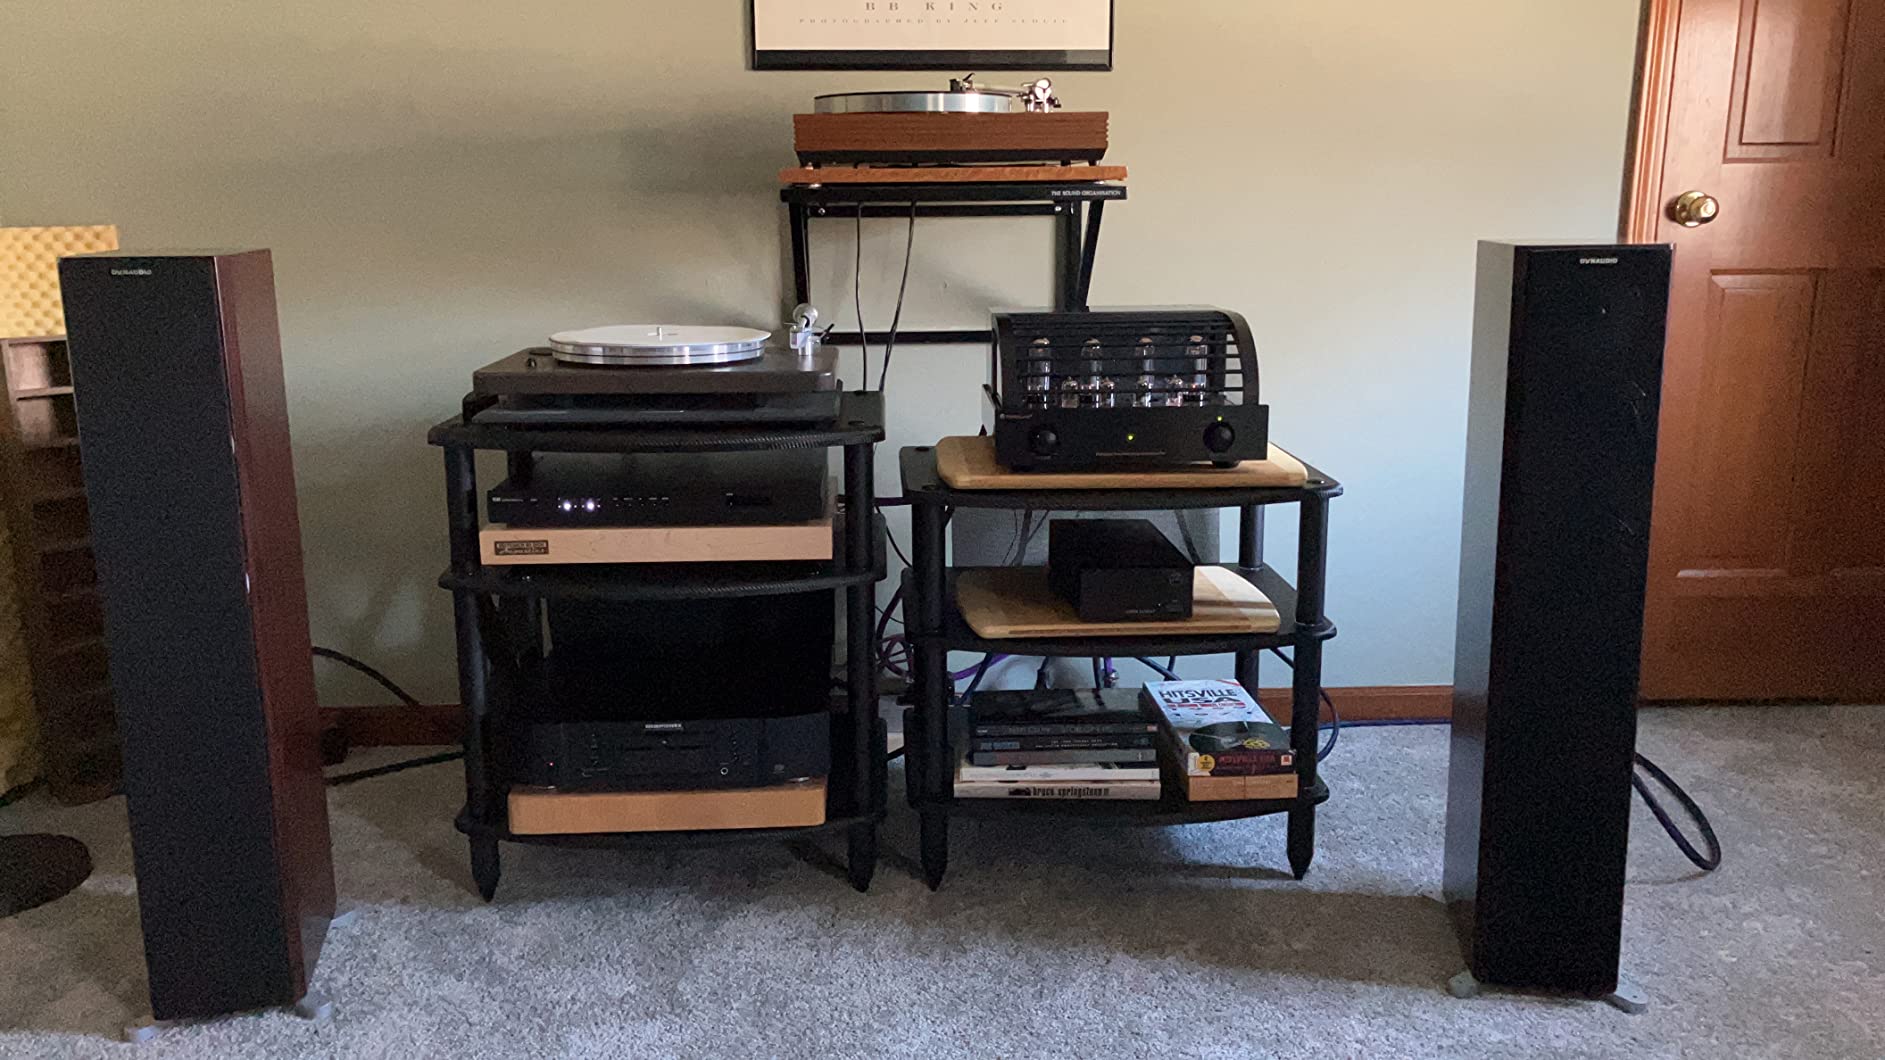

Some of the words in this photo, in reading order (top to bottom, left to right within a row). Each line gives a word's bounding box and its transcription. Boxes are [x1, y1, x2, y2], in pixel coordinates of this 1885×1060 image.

[926, 2, 1003, 11] KING
[1160, 688, 1237, 699] HITSVILLE
[1032, 786, 1055, 797] bruce
